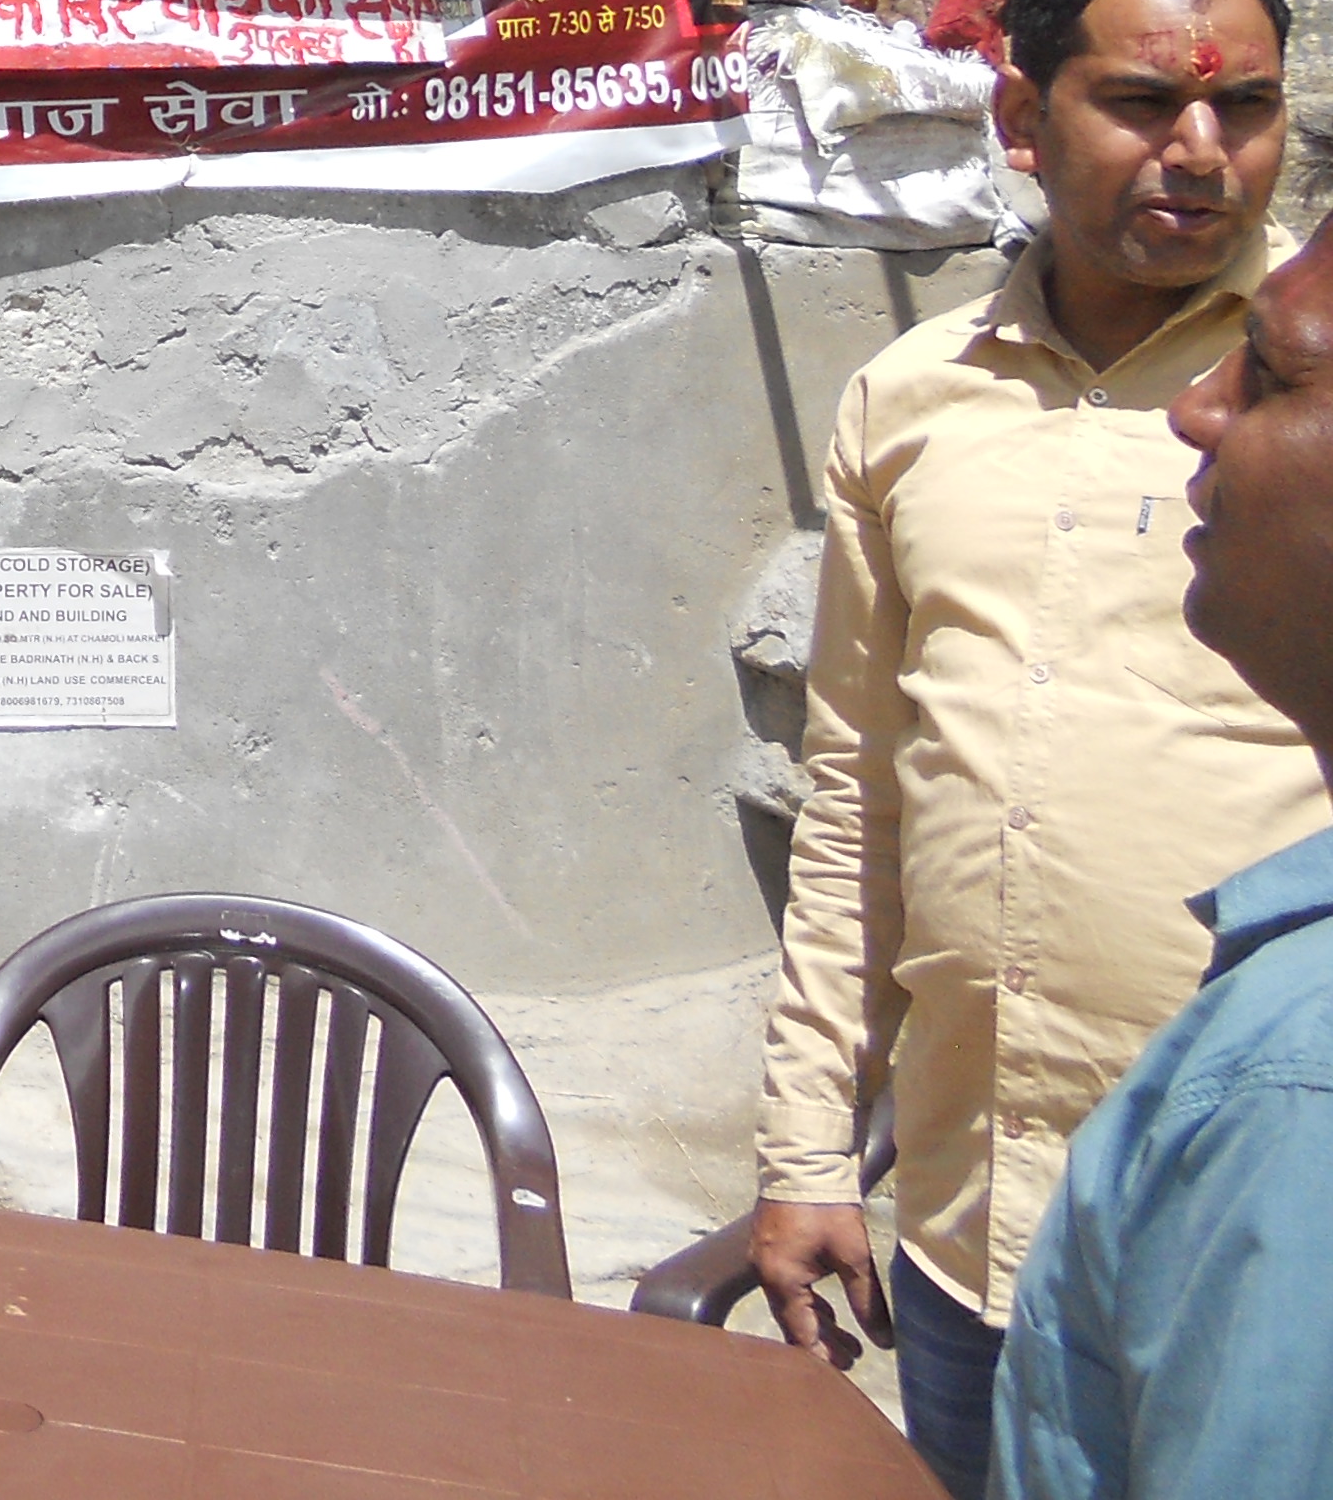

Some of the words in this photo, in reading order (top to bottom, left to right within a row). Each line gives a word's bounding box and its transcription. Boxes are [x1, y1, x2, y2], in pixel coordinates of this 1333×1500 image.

[548, 9, 593, 37] 7:30
[596, 5, 616, 33] से
[622, 3, 667, 32] 7:50
[144, 81, 308, 137] सेवा
[0, 557, 51, 573] COLD
[55, 557, 152, 576] STORAGE)
[57, 584, 95, 599] FOR
[99, 583, 153, 601] SALE)
[18, 609, 52, 623] AND
[55, 609, 129, 623] BUILDING
[67, 634, 80, 644] AT
[80, 634, 126, 644] CHAMOLI
[10, 654, 75, 664] BADRINATH
[106, 654, 115, 664] &
[117, 654, 149, 664] BACK
[29, 675, 60, 686] LAND
[64, 675, 87, 686] USE
[90, 675, 167, 686] COMMERCEAL
